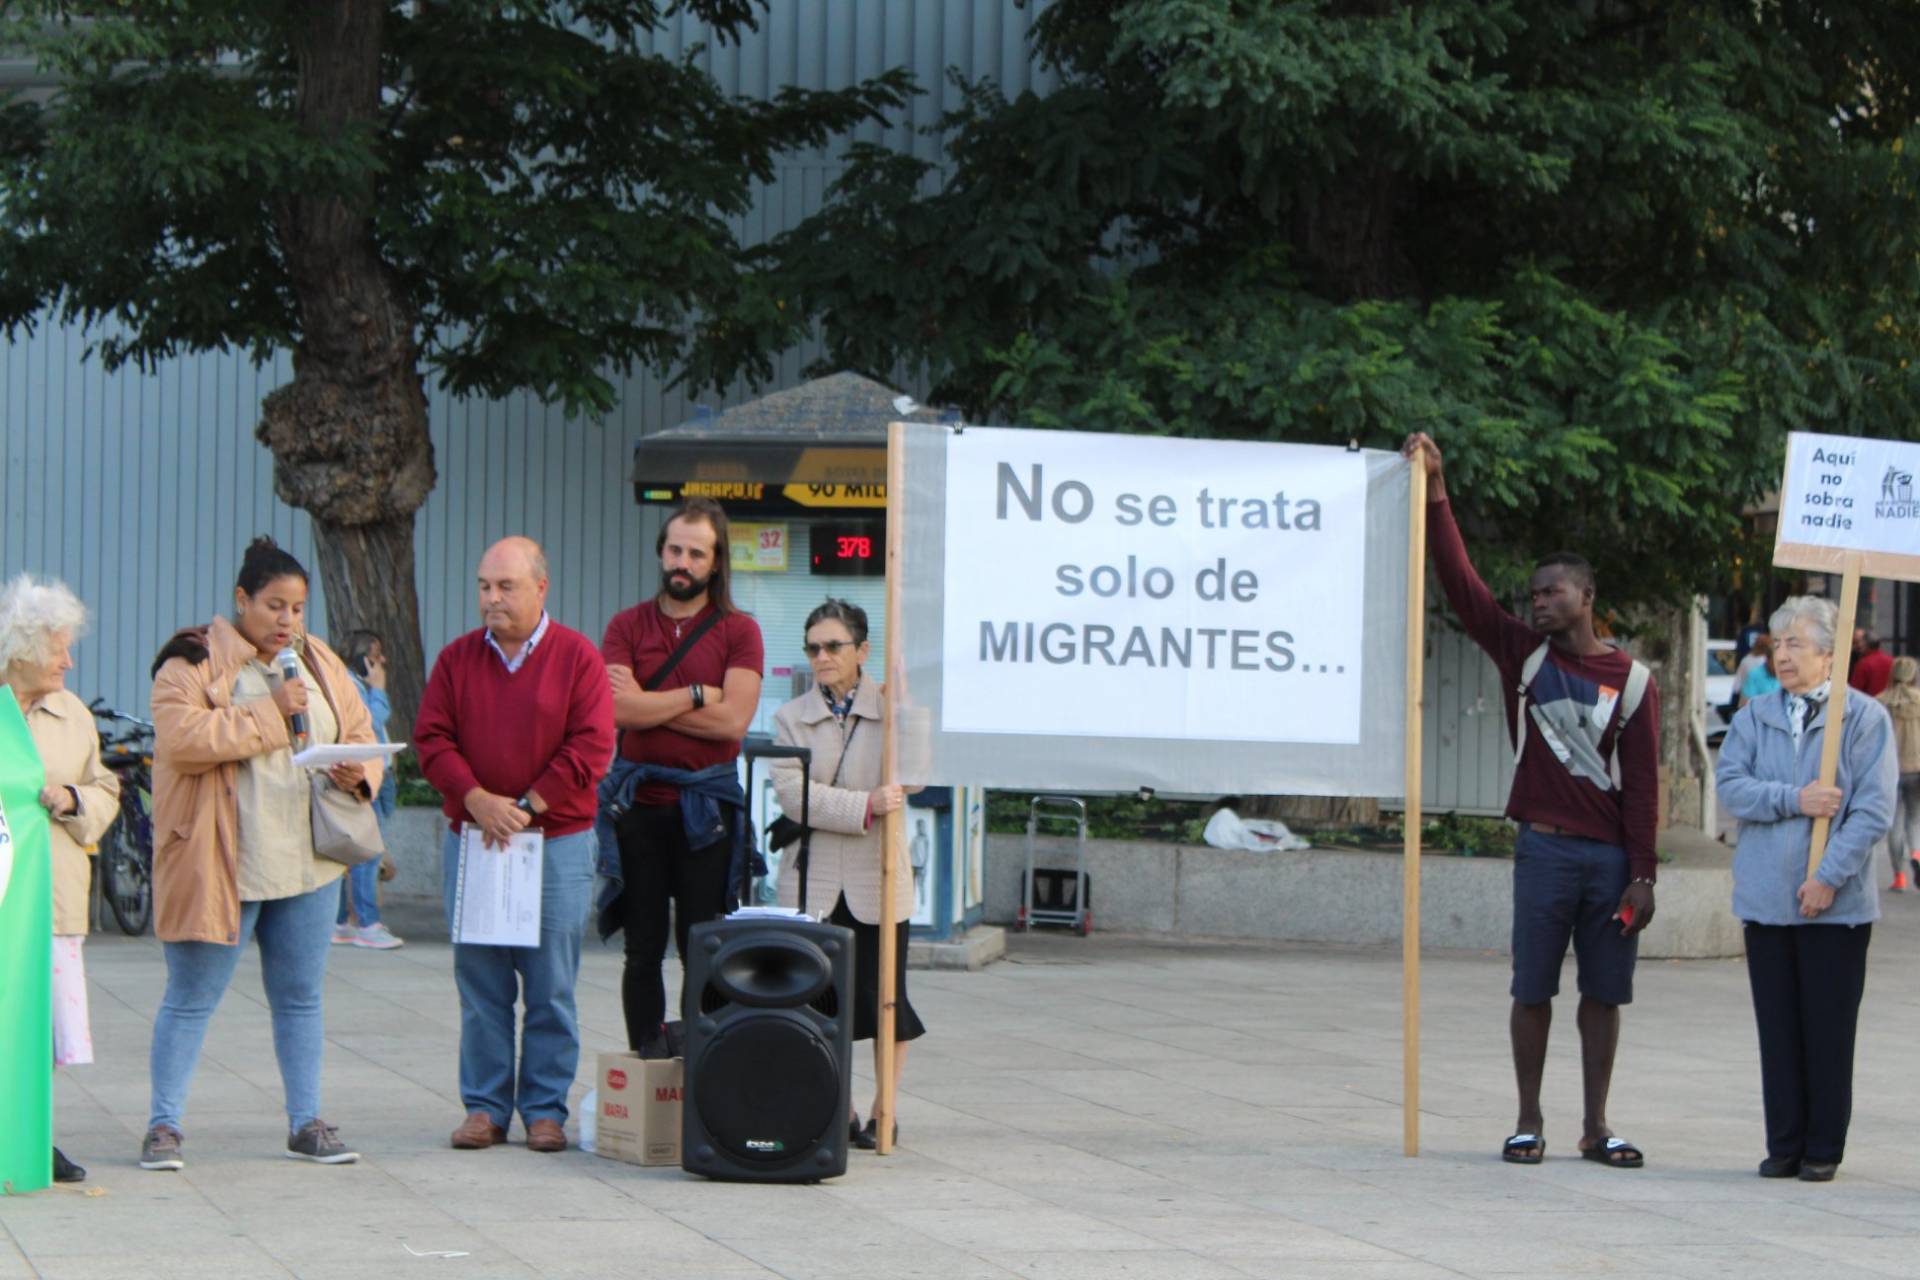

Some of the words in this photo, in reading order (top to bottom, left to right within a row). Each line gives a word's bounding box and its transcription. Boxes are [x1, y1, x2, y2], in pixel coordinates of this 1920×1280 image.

[1812, 447, 1856, 467] Aquí
[1820, 474, 1843, 486] no
[996, 461, 1094, 524] No
[1115, 493, 1177, 527] se
[1196, 487, 1322, 531] trata
[1804, 491, 1854, 509] sobra
[1801, 513, 1853, 530] nadie
[760, 530, 782, 549] 32
[837, 536, 872, 558] 378
[1055, 554, 1175, 600] solo
[1195, 557, 1259, 603] de
[979, 621, 1346, 674] MIGRANTES...
